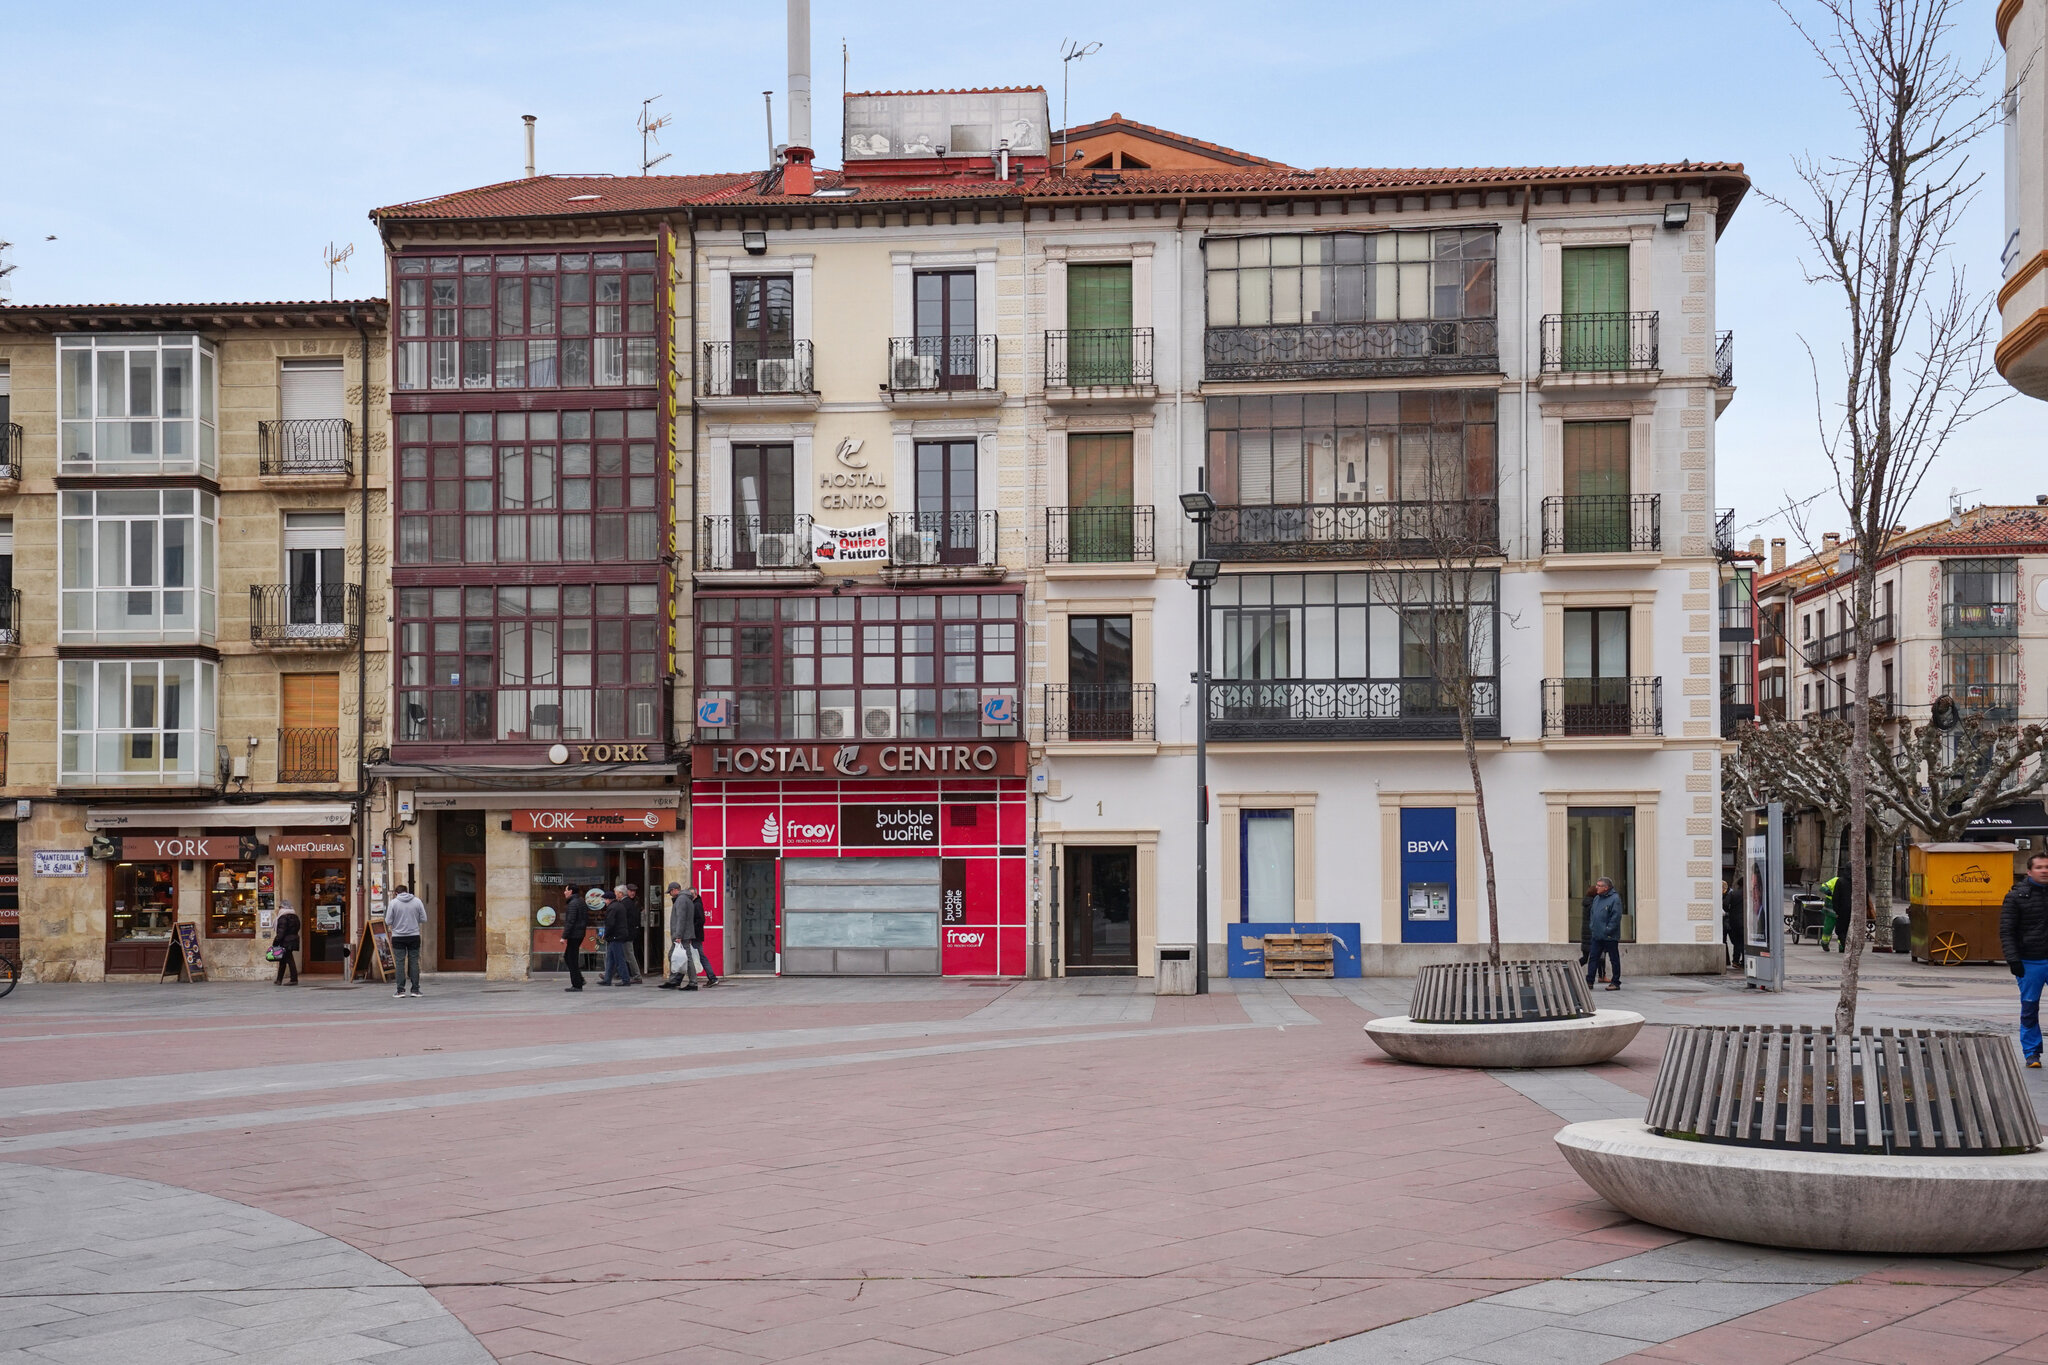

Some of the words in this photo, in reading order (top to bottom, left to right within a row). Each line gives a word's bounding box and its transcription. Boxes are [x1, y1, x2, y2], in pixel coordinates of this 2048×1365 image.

[668, 232, 677, 553] MANTEQUERIAS
[820, 473, 886, 488] HOSTAL
[821, 495, 887, 509] CENTRO
[830, 527, 876, 539] #Soria
[840, 538, 886, 550] Quiere
[840, 549, 887, 560] Futuro
[668, 571, 677, 675] YORK
[578, 744, 649, 762] YORK
[713, 747, 824, 772] HOSTAL
[879, 746, 997, 771] CENTRO
[1096, 800, 1103, 816] 1
[529, 812, 575, 828] YORK
[585, 813, 624, 824] EXPRÉS
[877, 809, 933, 827] bubble
[787, 820, 836, 842] frooy
[883, 825, 933, 841] waffle
[154, 840, 209, 856] YORK
[276, 842, 345, 852] MANTEQUERIAS
[1408, 840, 1449, 852] BBVA
[38, 853, 79, 862] MANTEQUILLA
[944, 890, 955, 921] bubble
[953, 890, 962, 918] waffle
[947, 929, 985, 947] frooy
